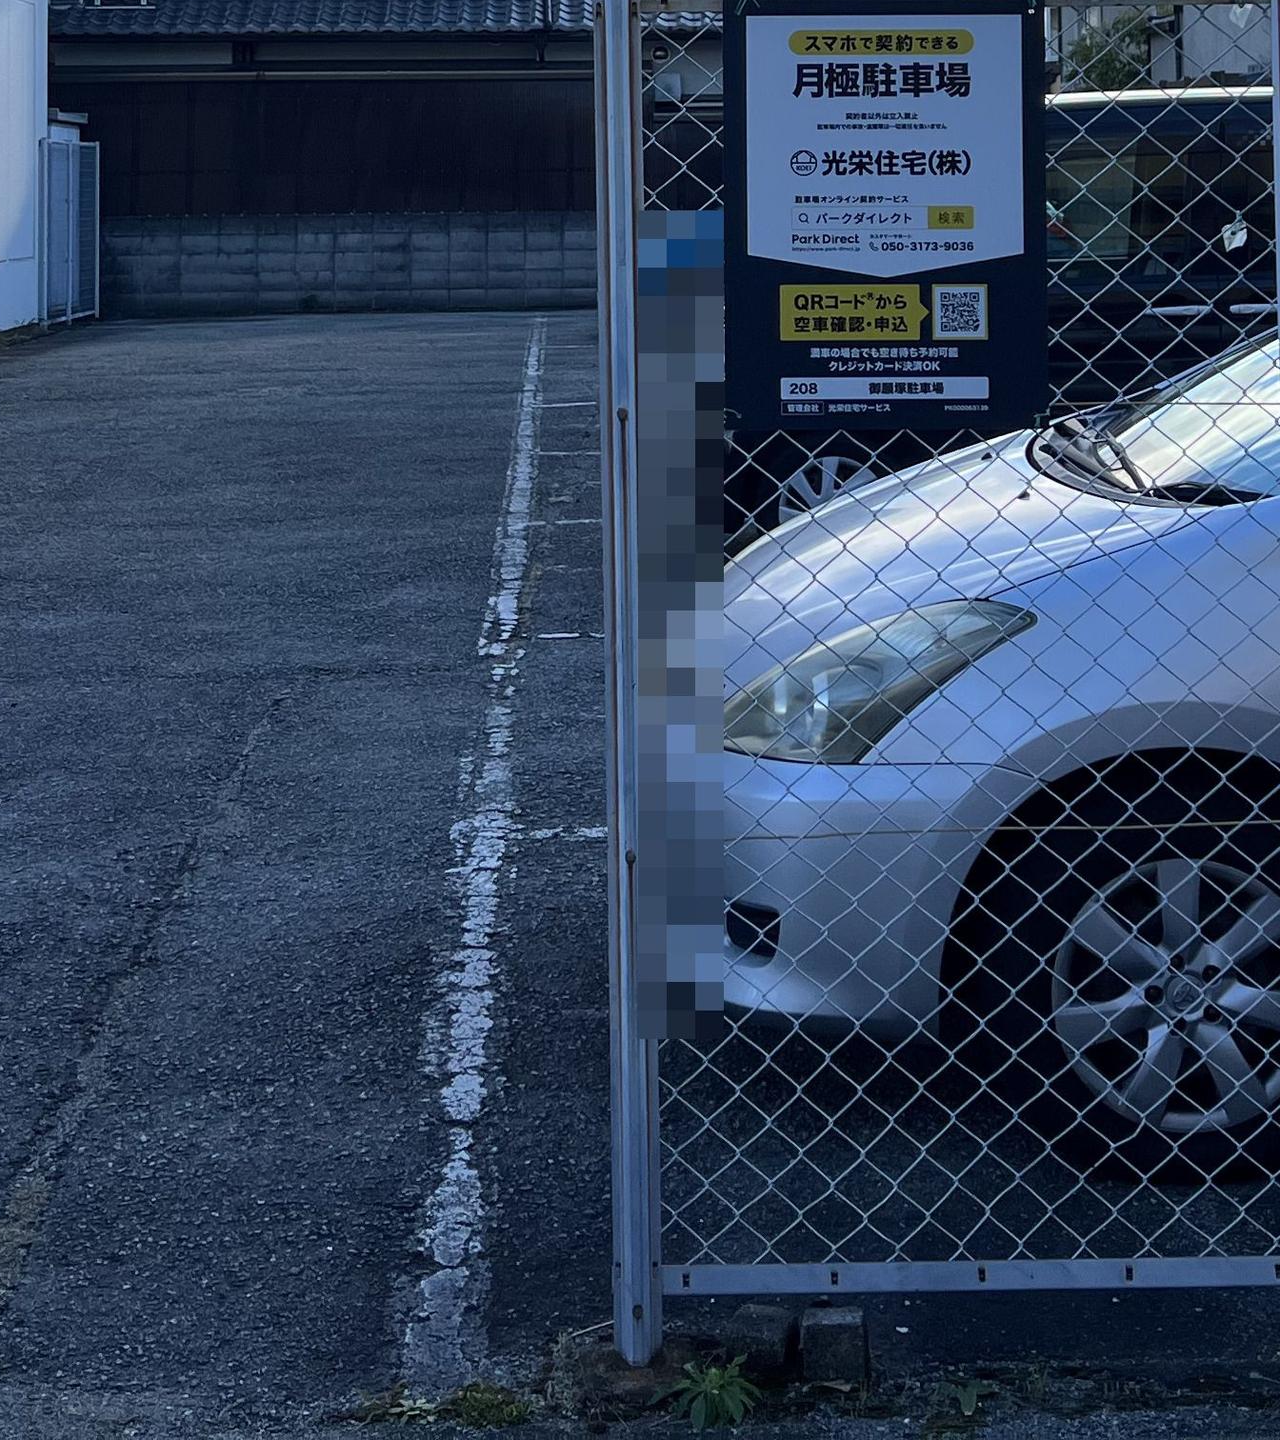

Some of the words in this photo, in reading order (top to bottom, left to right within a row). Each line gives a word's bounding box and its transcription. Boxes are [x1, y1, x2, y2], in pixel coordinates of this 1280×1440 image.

[805, 34, 959, 52] スマホで契約できる
[792, 62, 972, 98] 月極駐車場
[821, 150, 971, 176] 光栄住宅(株)
[795, 195, 909, 203] 駐車場オンライン契約サービス
[816, 212, 913, 225] パークダイレクト
[938, 211, 966, 224] 検索
[792, 234, 820, 244] Park
[823, 234, 860, 244] Direct
[881, 242, 974, 252] 050-3173-9036
[793, 316, 908, 333] 空車確認・申込
[829, 361, 940, 371] クレジットカード決済OK
[789, 383, 818, 395] 208
